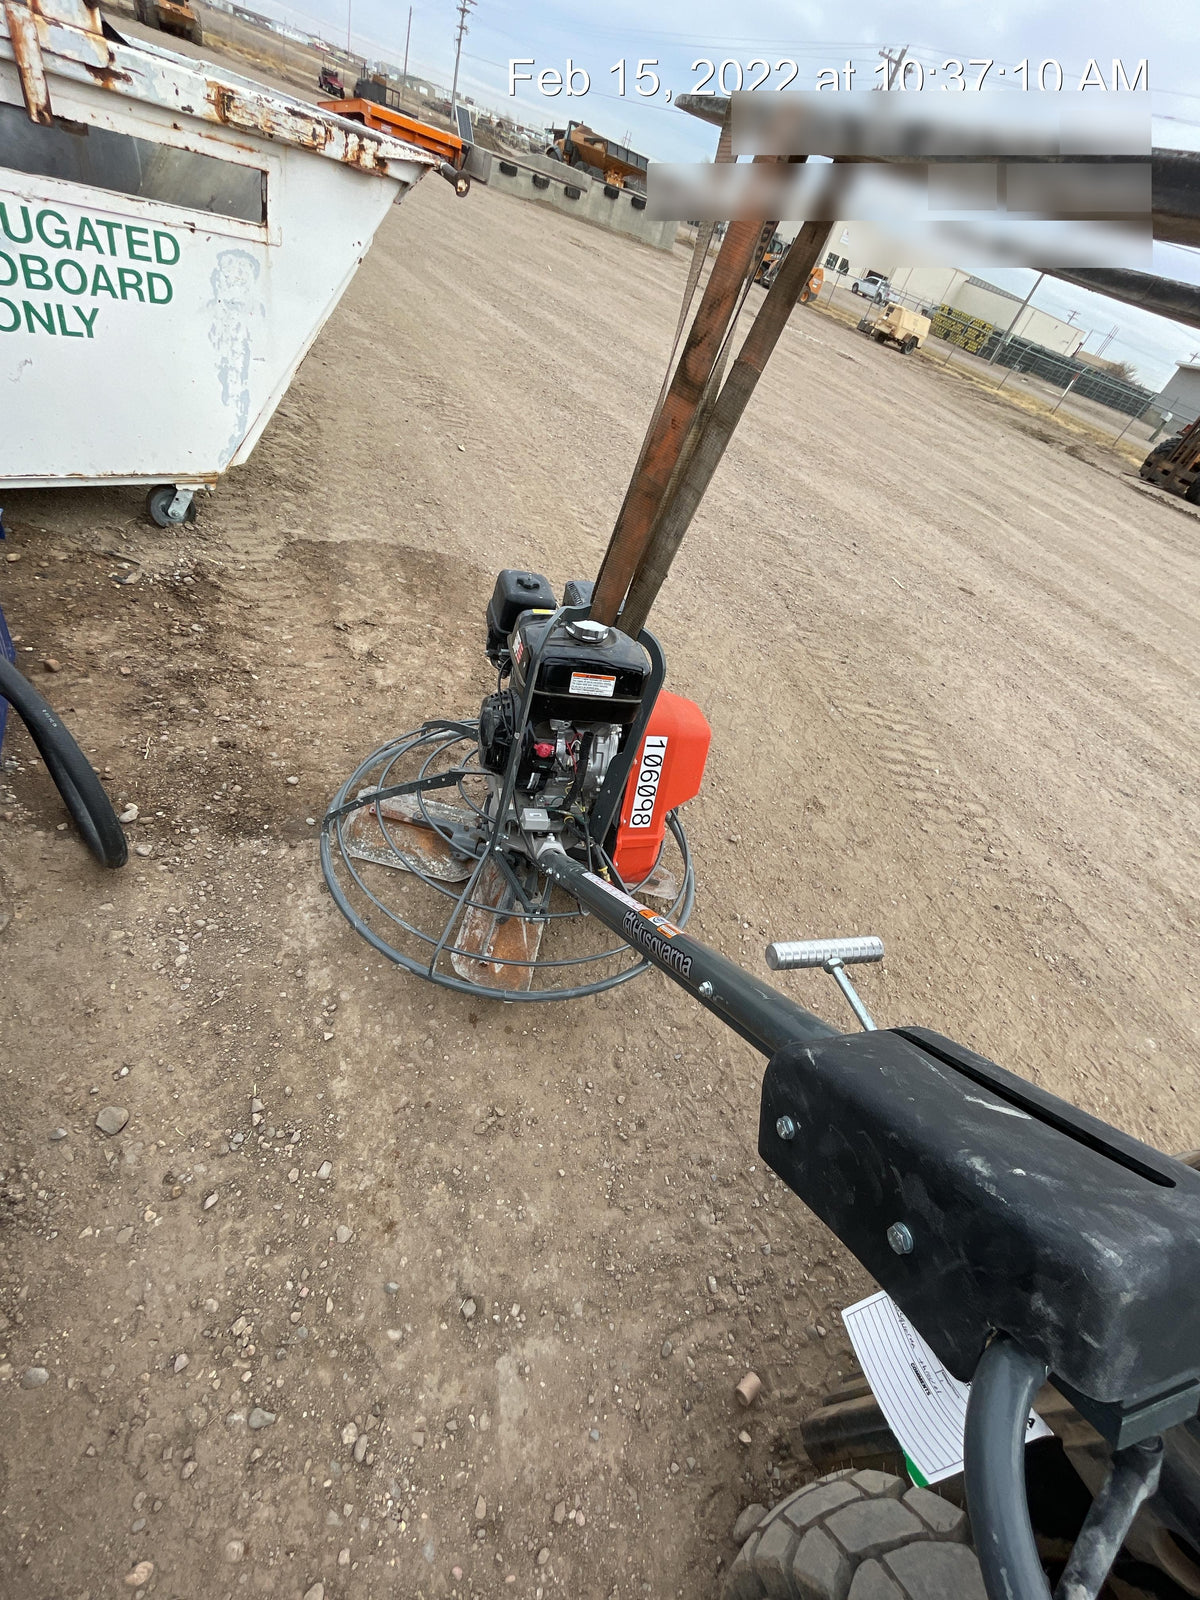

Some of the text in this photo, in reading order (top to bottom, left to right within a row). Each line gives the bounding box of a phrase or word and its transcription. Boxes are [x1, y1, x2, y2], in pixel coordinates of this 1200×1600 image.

[0, 296, 100, 338] ONLY
[631, 739, 666, 826] 106098
[632, 919, 694, 979] Husqvarna
[910, 1362, 932, 1396] COMMENTS
